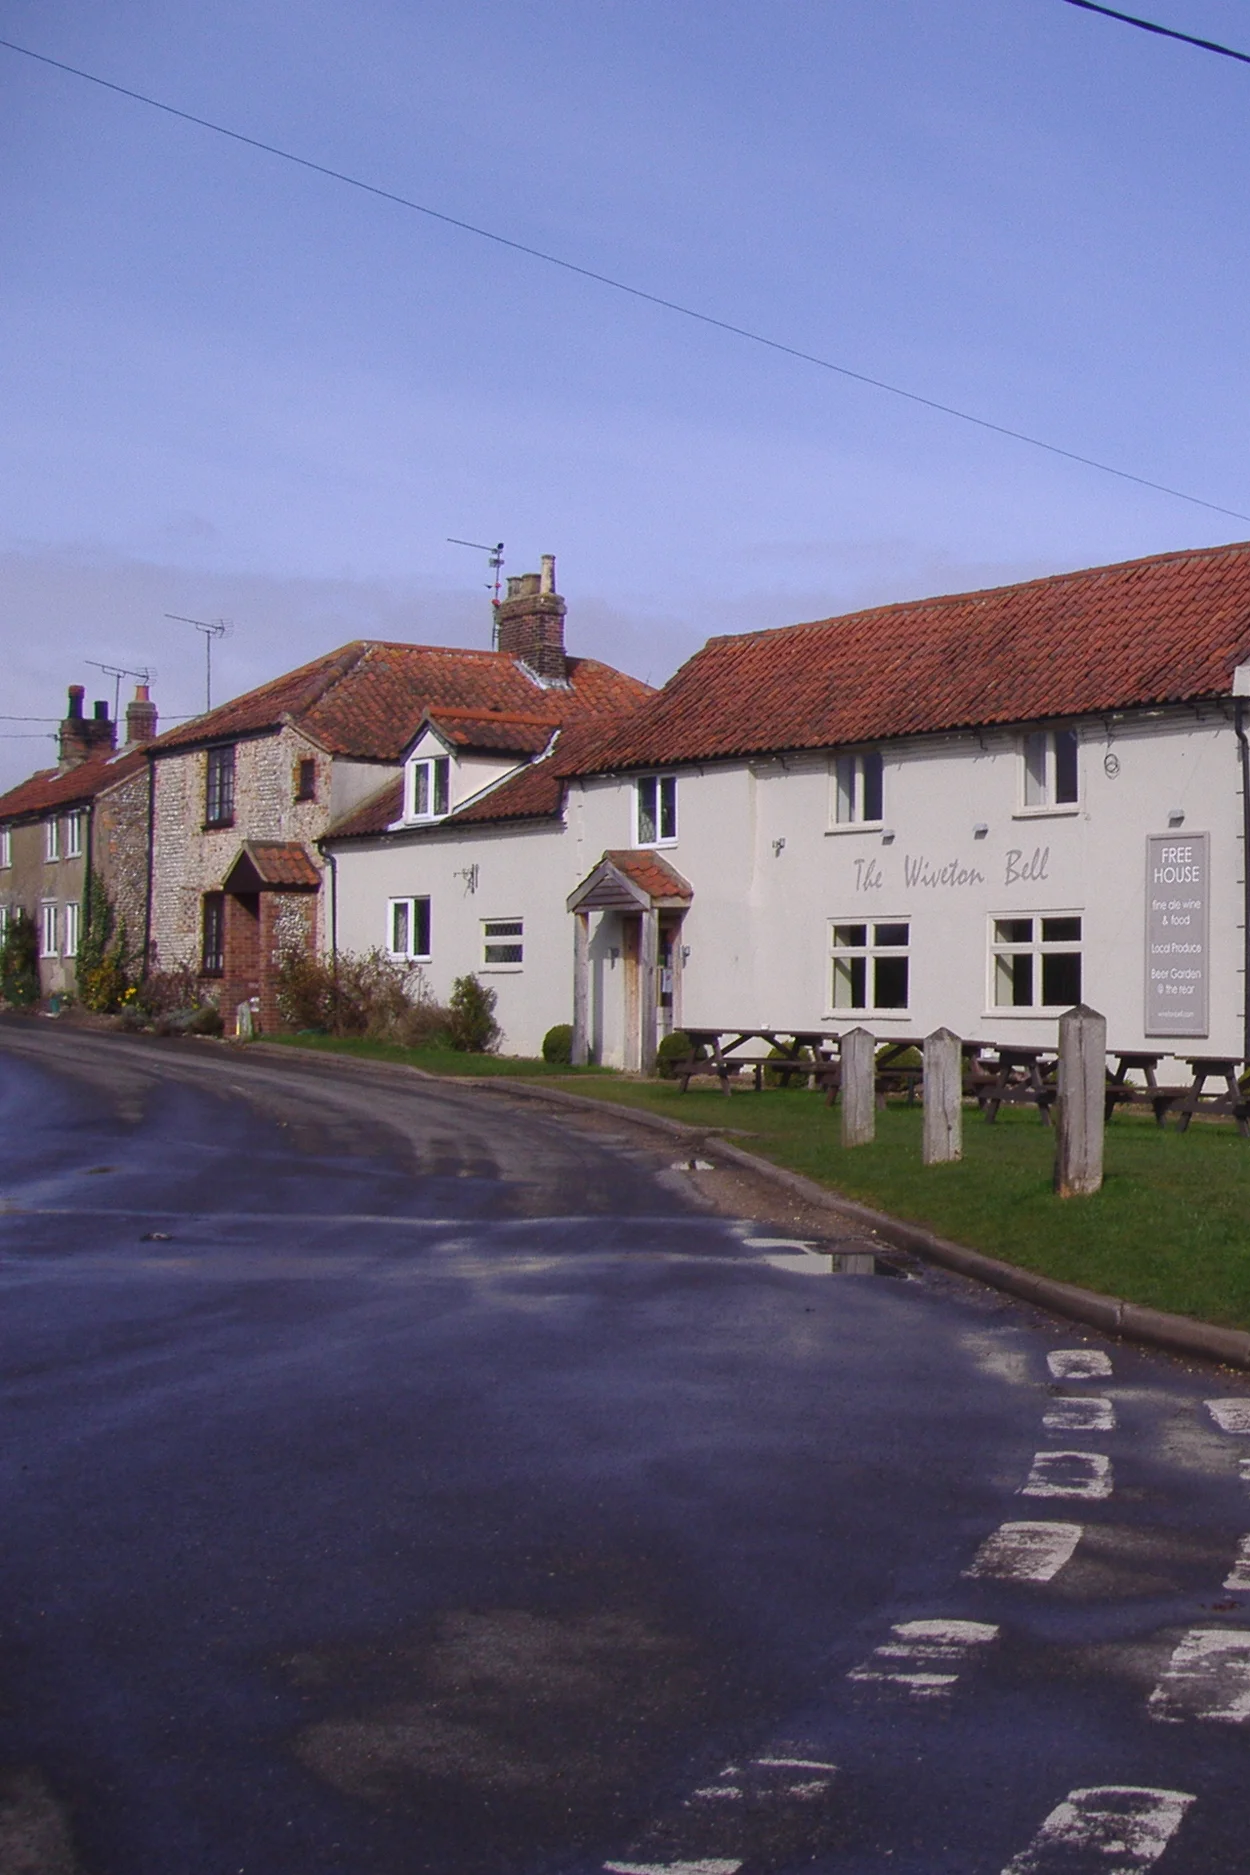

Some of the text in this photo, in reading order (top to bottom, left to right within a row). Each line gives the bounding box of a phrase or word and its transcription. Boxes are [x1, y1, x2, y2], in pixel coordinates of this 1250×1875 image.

[1161, 846, 1193, 863] FREE
[854, 845, 1051, 891] The Wiveton Bell
[1154, 865, 1200, 884] HOUSE
[1152, 898, 1202, 910] fine ale wine
[1162, 914, 1191, 926] & food
[1151, 942, 1202, 954] Local Produce
[1151, 967, 1202, 979] Beer Garden
[1165, 984, 1178, 994] the
[1179, 984, 1195, 995] rear
